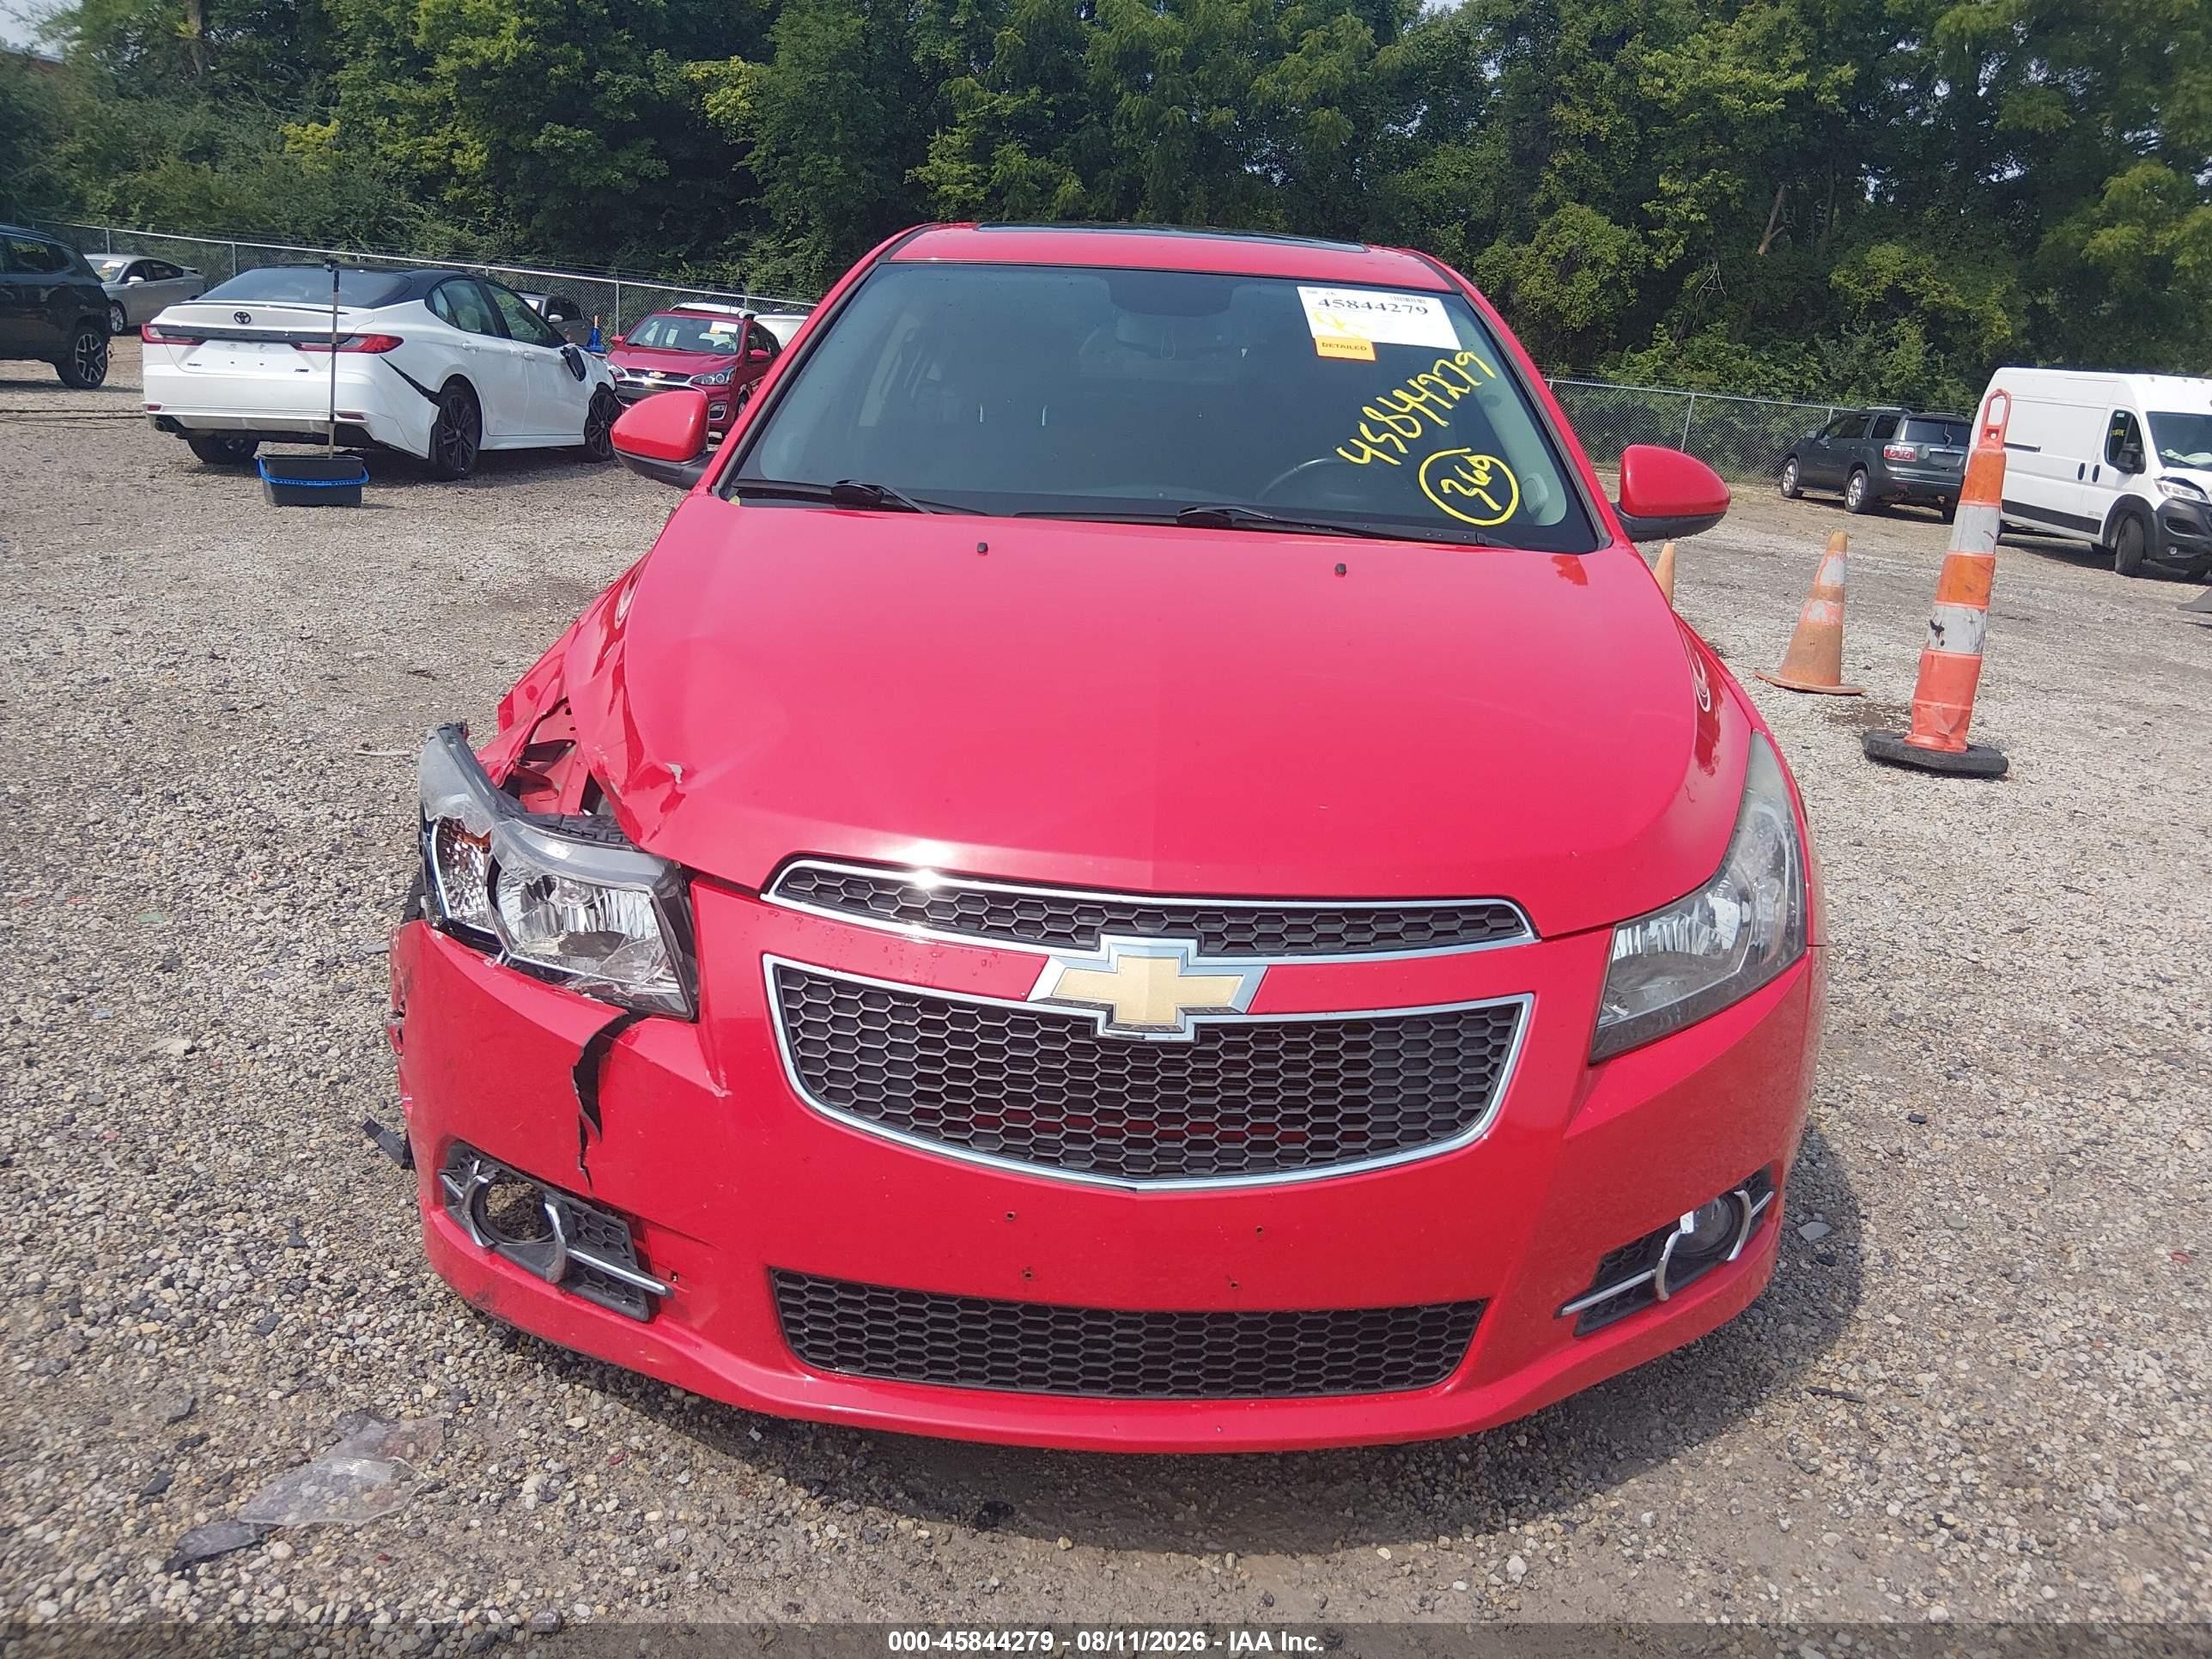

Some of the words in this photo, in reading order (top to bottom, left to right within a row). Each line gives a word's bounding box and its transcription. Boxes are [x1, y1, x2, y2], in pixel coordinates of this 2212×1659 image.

[1318, 298, 1429, 315] 45844279
[1321, 342, 1368, 351] DETAILED
[1335, 350, 1497, 465] 45844279
